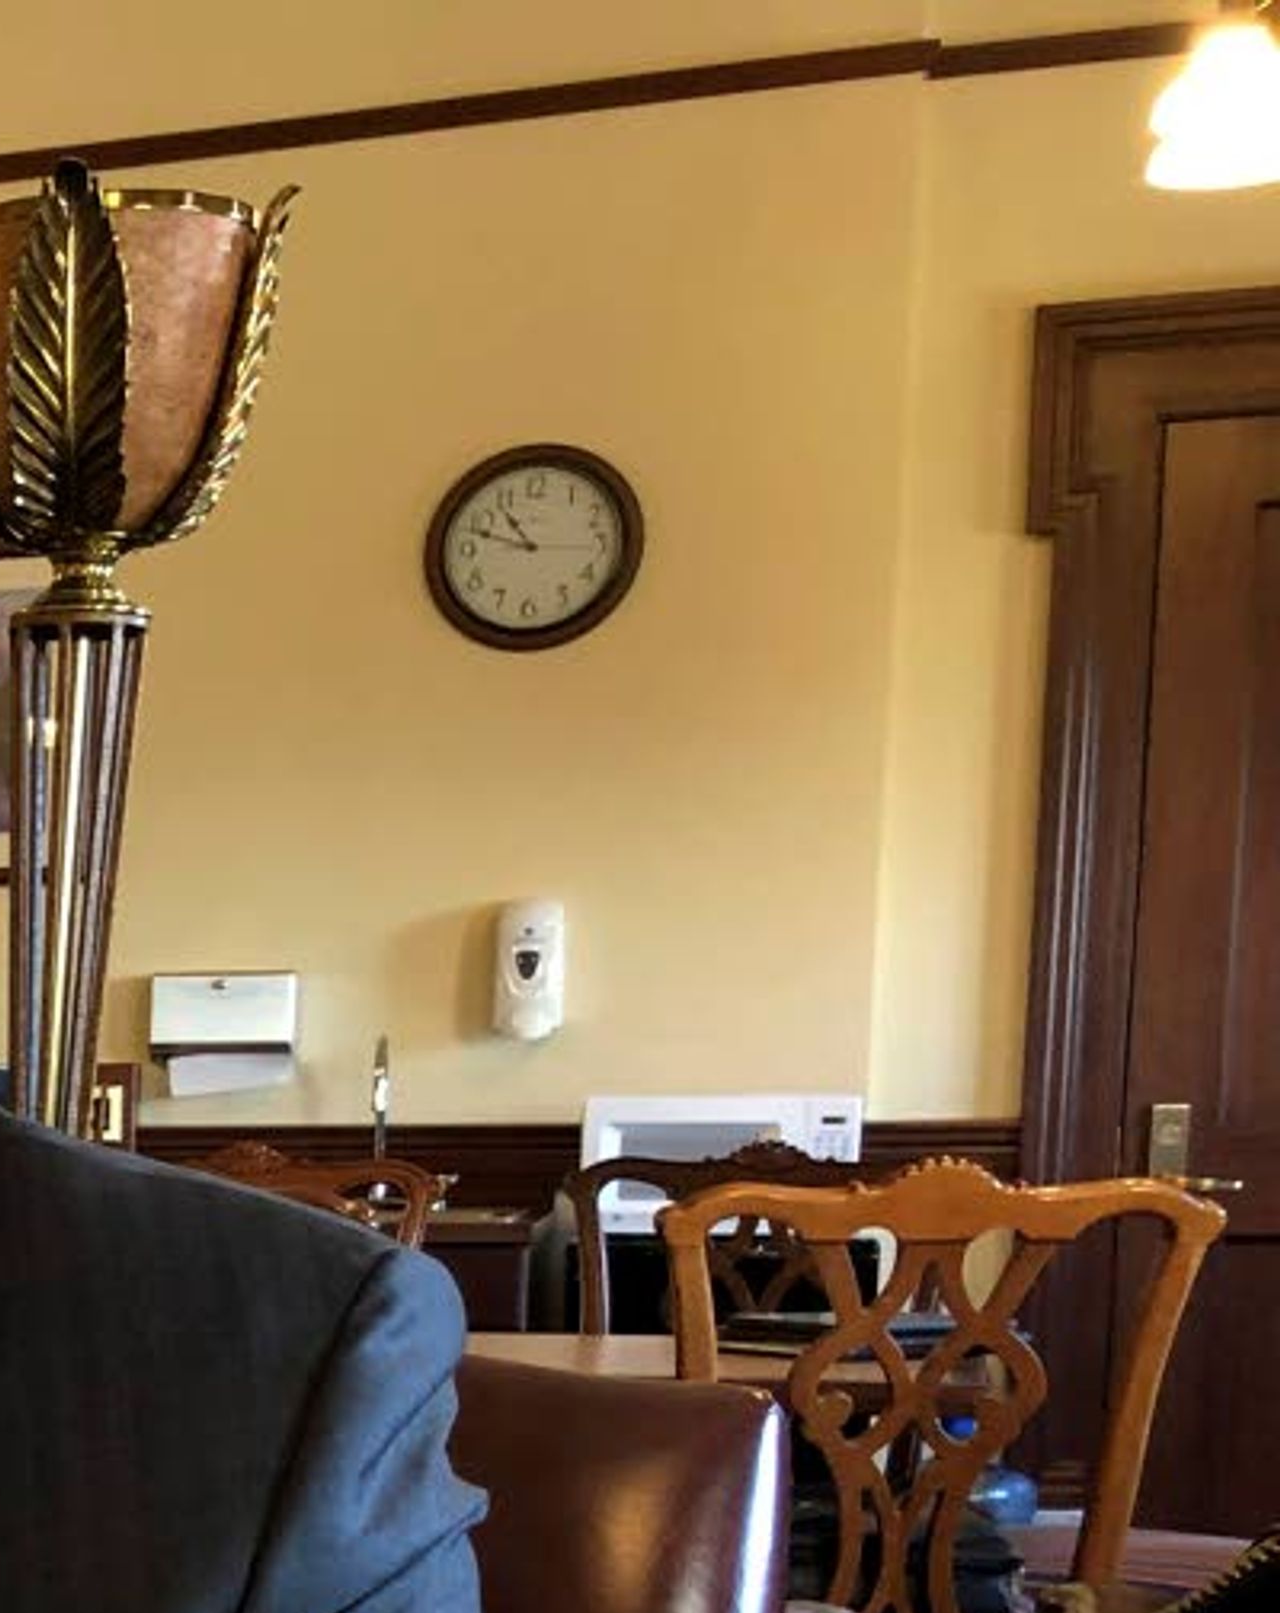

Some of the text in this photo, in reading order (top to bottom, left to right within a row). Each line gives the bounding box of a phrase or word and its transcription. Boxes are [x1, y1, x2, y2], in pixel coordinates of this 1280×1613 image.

[569, 485, 575, 508] 1
[493, 587, 507, 612] 7
[519, 599, 538, 619] 6
